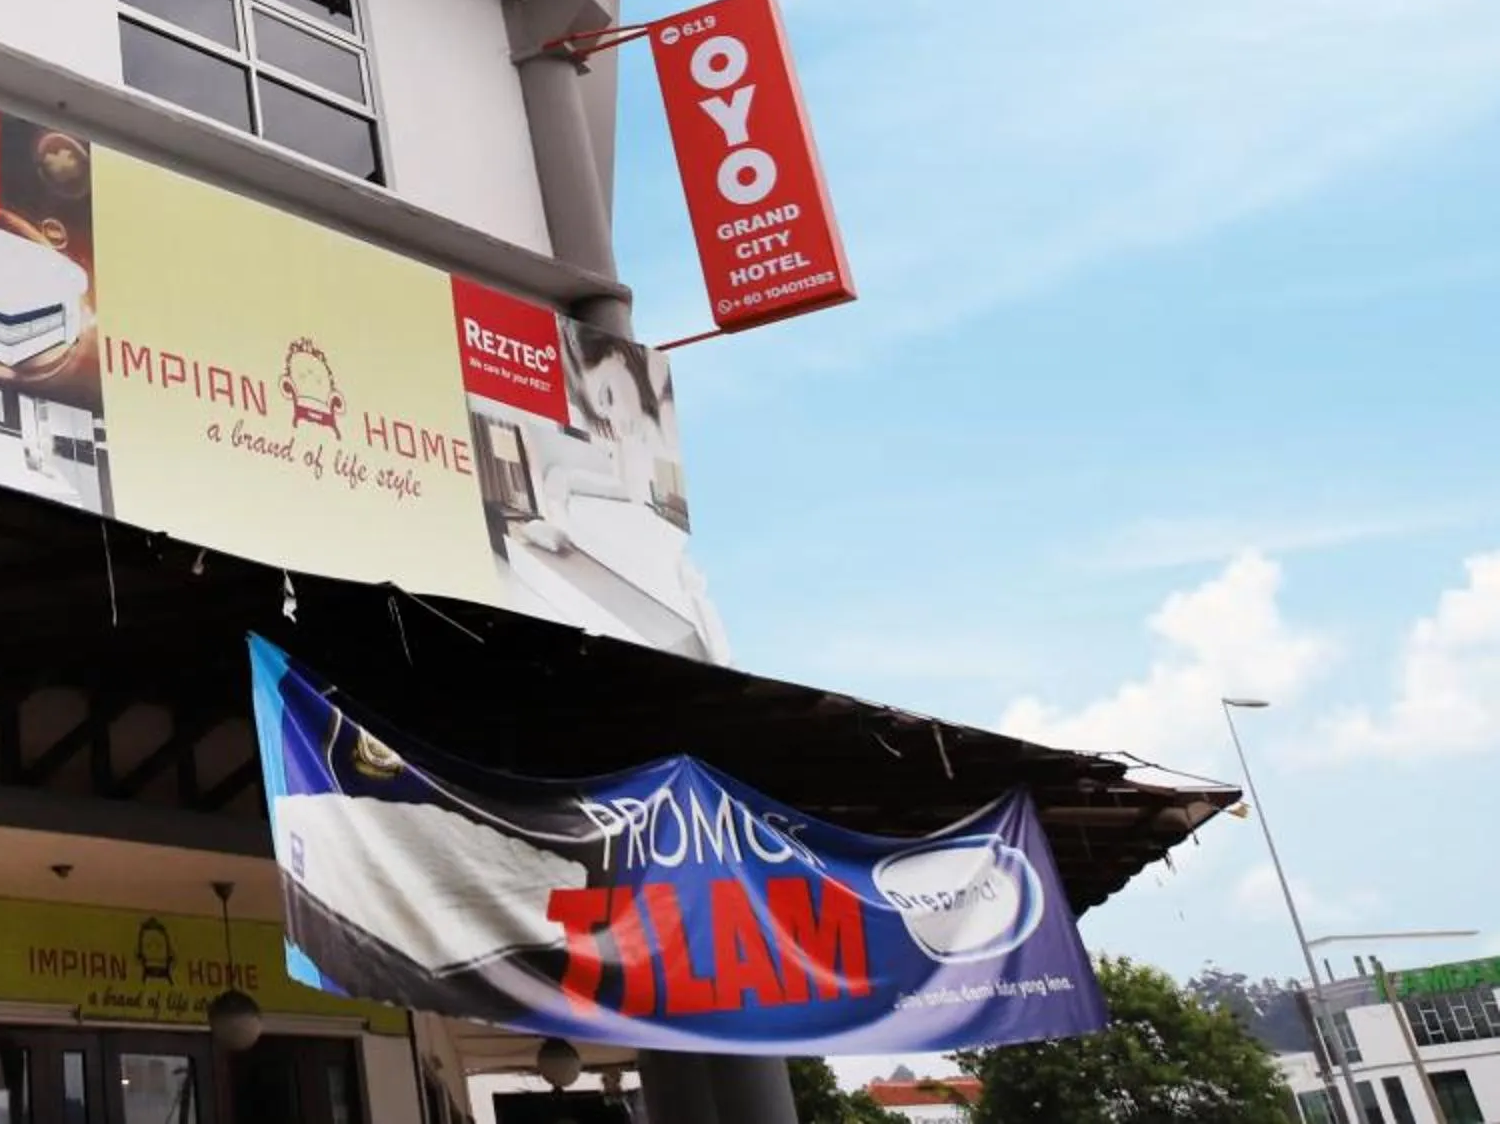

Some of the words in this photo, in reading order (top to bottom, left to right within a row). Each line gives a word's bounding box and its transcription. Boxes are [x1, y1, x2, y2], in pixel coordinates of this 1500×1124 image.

[689, 35, 778, 205] OYO
[716, 204, 801, 241] GRAND
[736, 229, 790, 259] CITY
[729, 252, 811, 287] HOTEL
[463, 317, 550, 374] REZTEC
[105, 336, 267, 416] IMPIAN
[363, 411, 473, 476] HOME
[206, 424, 222, 443] a
[230, 419, 295, 463] brand
[303, 443, 324, 480] of
[334, 448, 368, 489] life
[376, 467, 421, 501] style
[28, 945, 128, 981] IMPIAN
[187, 959, 260, 990] HOME
[546, 877, 871, 1018] TILAM
[102, 986, 143, 1008] brand
